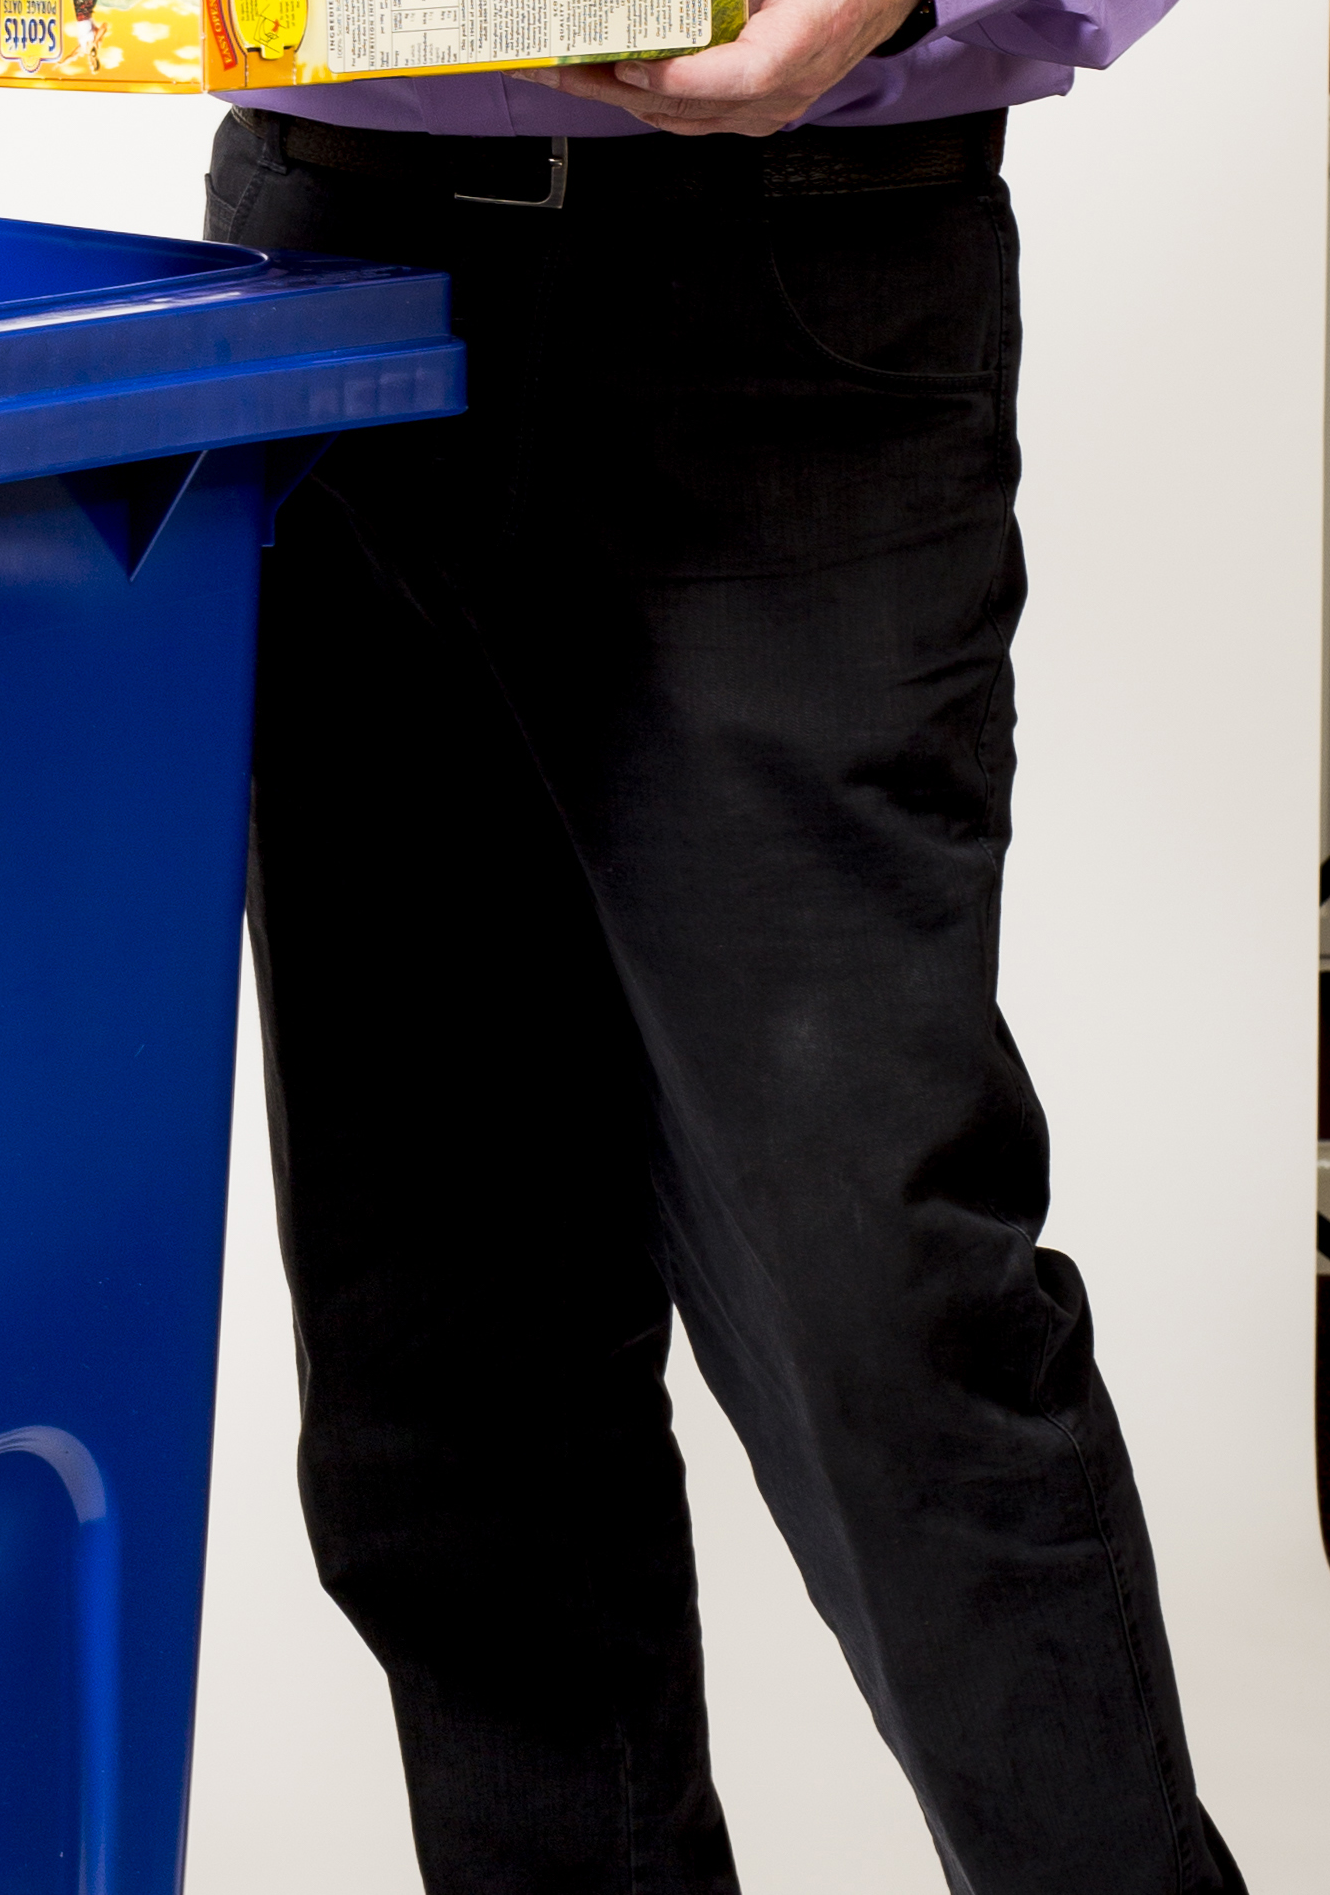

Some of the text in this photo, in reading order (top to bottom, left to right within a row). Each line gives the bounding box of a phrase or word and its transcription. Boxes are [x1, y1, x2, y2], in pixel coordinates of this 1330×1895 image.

[2, 0, 56, 14] PORAGE OATS
[217, 33, 233, 63] EASY
